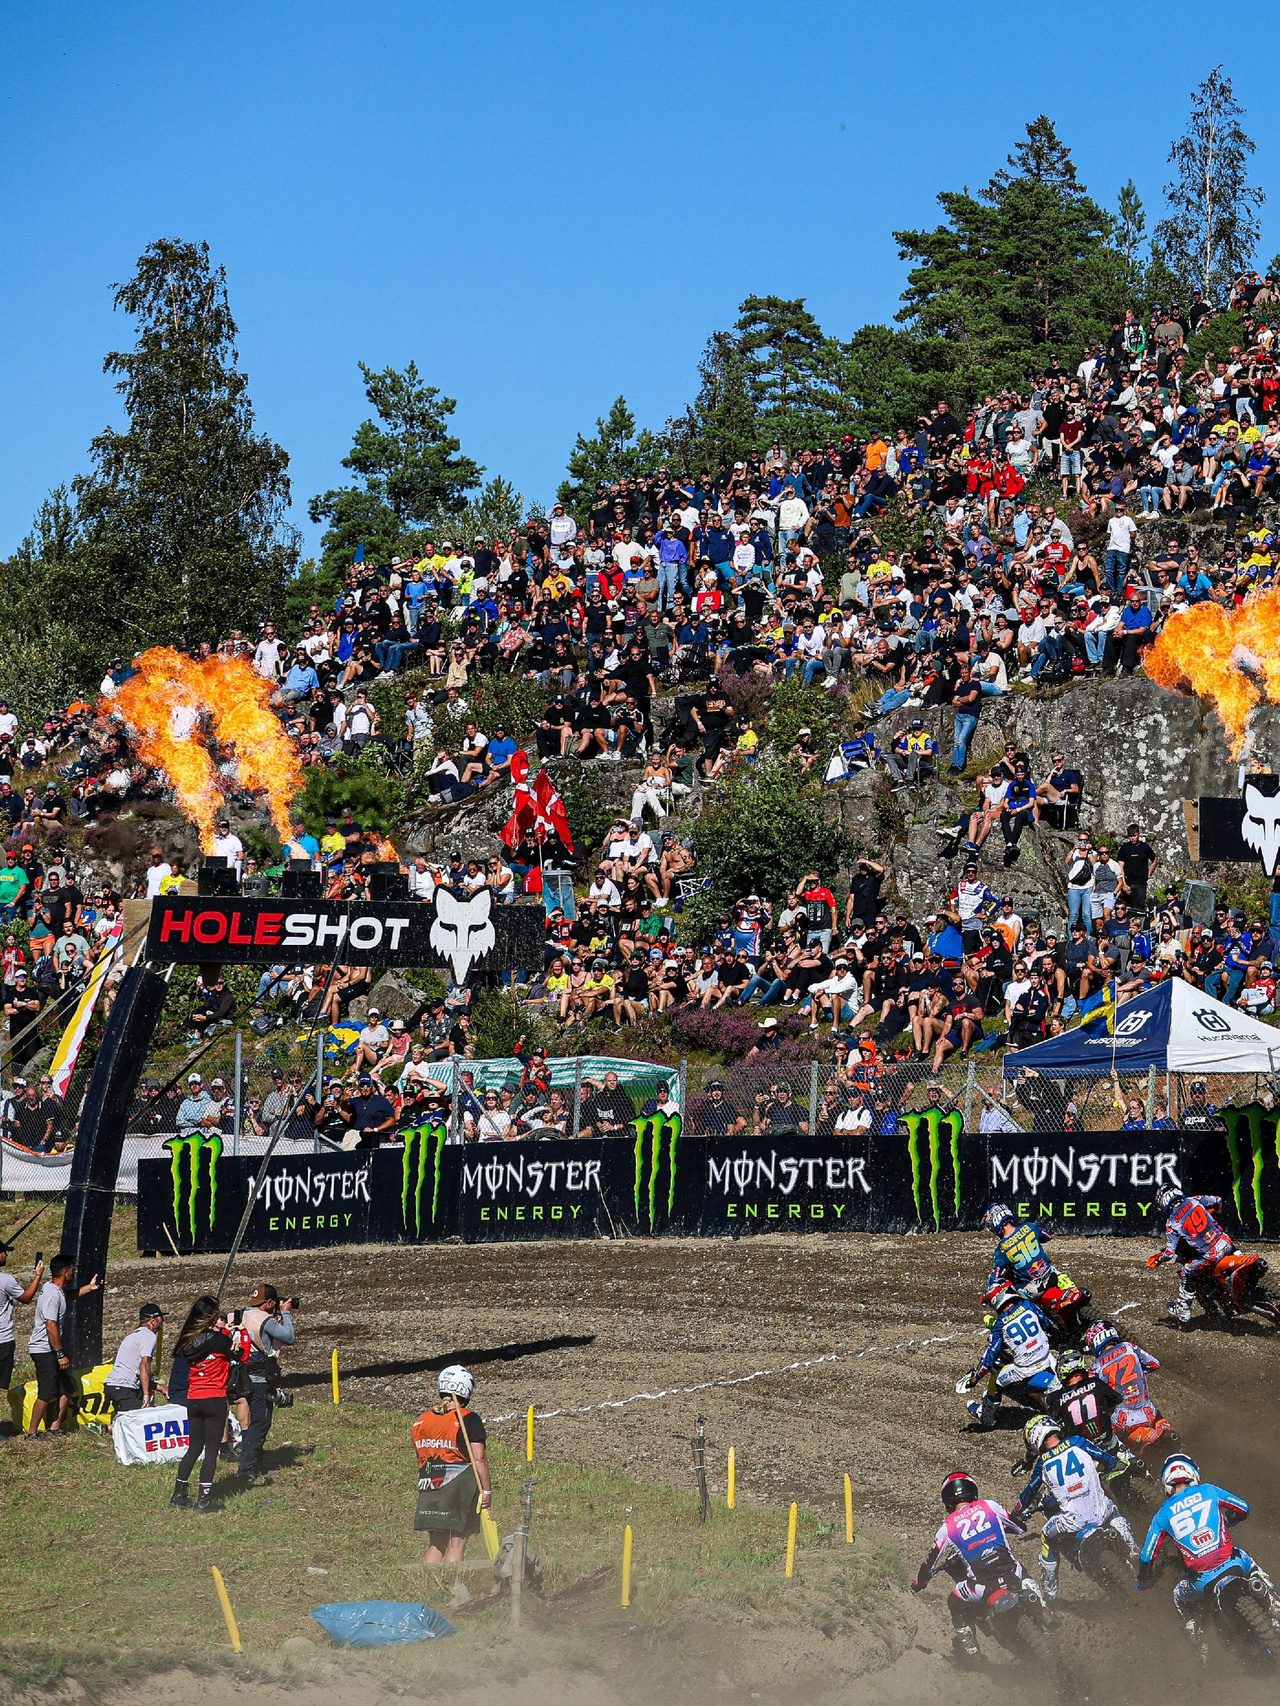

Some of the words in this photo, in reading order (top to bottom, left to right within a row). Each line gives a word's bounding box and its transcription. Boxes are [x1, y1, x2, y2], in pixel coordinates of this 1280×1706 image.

[160, 910, 410, 950] HOLESHOT
[463, 1154, 601, 1200] MONSTER
[707, 1150, 872, 1196] MONSTER
[991, 1146, 1182, 1196] MONSTER
[248, 1166, 371, 1211] MONSTER
[269, 1213, 352, 1231] ENERGY
[480, 1205, 581, 1221] ENERGY
[727, 1203, 846, 1218] ENERGY
[1017, 1202, 1152, 1218] ENERGY
[1182, 1205, 1208, 1240] 19
[1006, 1231, 1040, 1269] 516
[1006, 1314, 1039, 1345] 96
[1103, 1354, 1138, 1390] 72
[1060, 1382, 1096, 1406] HAARUP
[1067, 1393, 1097, 1426] 11
[1052, 1440, 1071, 1455] WOLF
[1045, 1450, 1085, 1487] 74
[1169, 1492, 1203, 1514] YAGO
[1170, 1499, 1212, 1540] 67
[956, 1510, 992, 1540] 22
